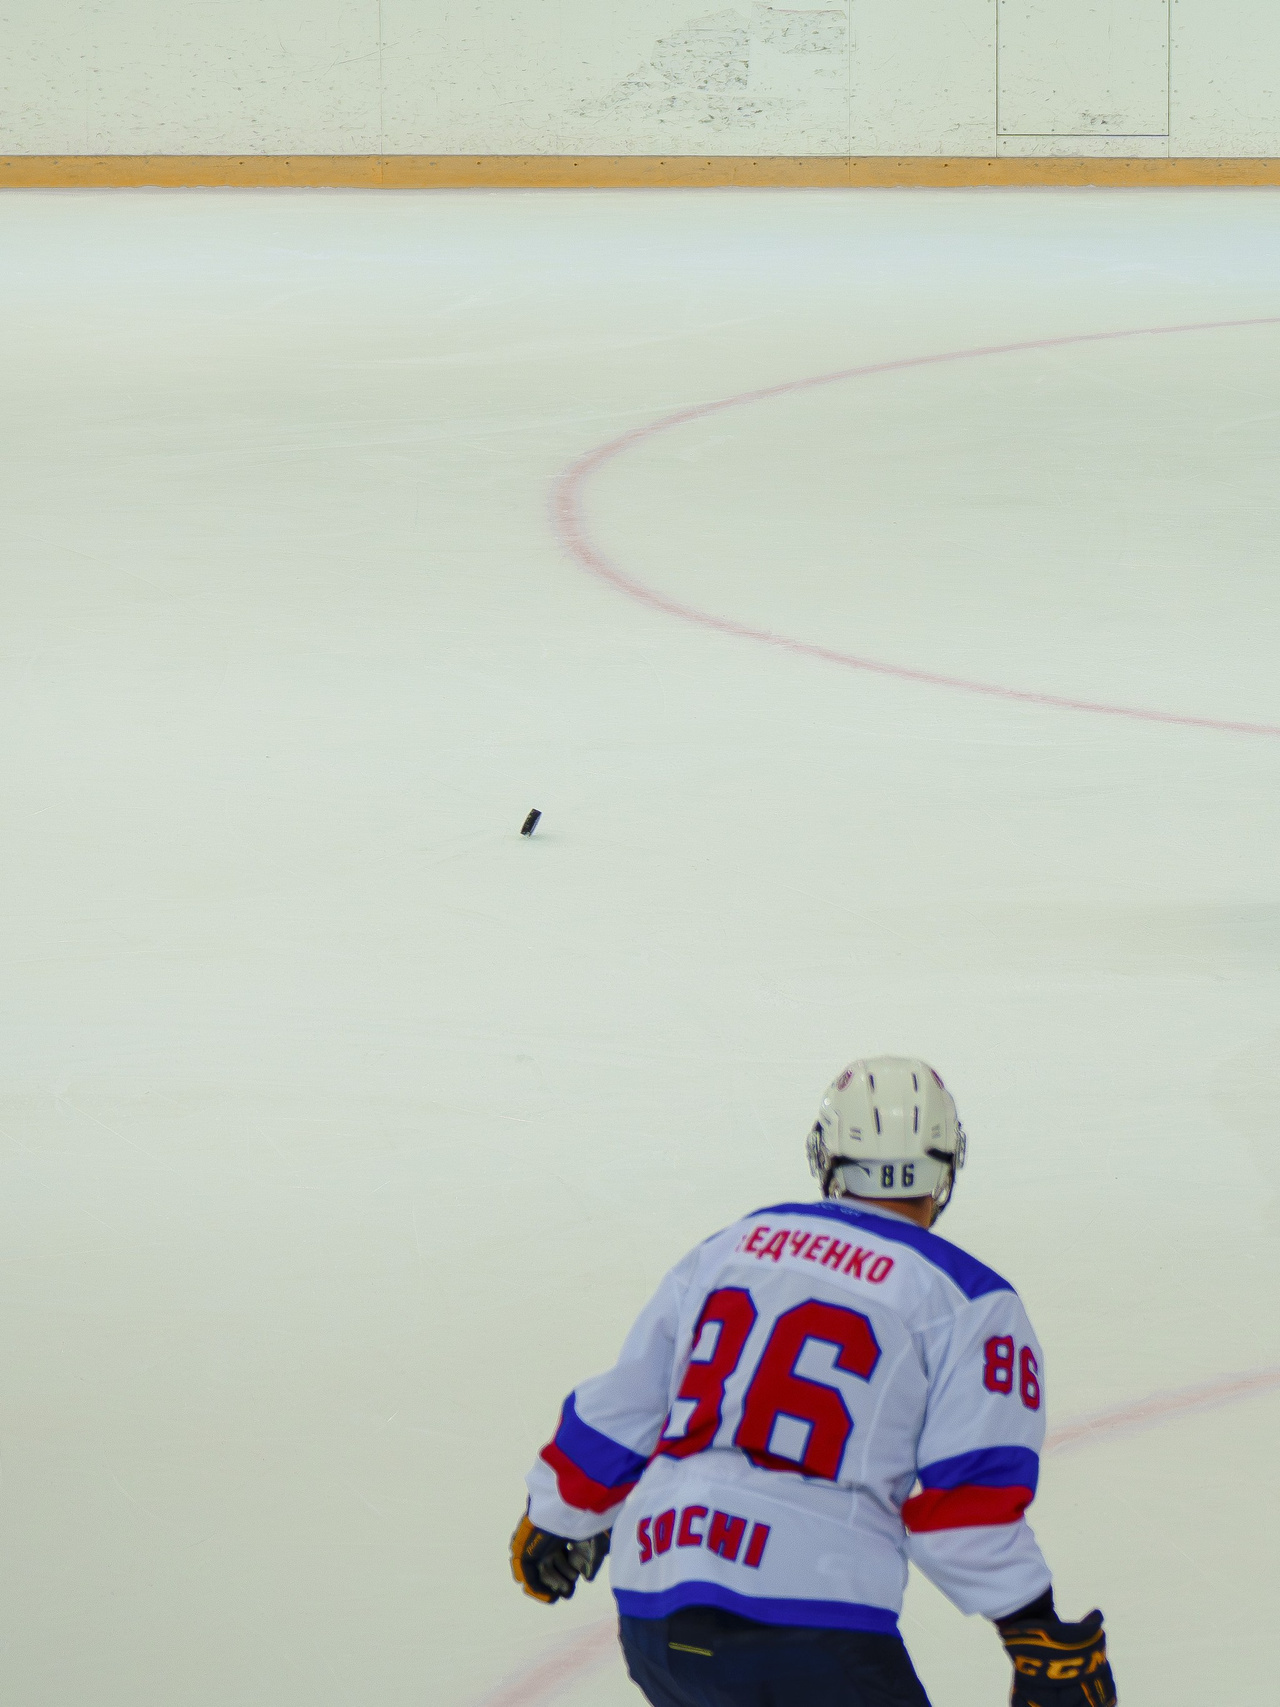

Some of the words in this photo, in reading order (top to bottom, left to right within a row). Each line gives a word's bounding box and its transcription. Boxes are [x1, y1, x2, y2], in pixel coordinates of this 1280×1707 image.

[880, 1162, 915, 1189] 86
[739, 1226, 895, 1285] ЕДЧЕНКО
[645, 1285, 882, 1482] 86
[982, 1333, 1042, 1411] 86
[636, 1504, 771, 1569] SOCHI
